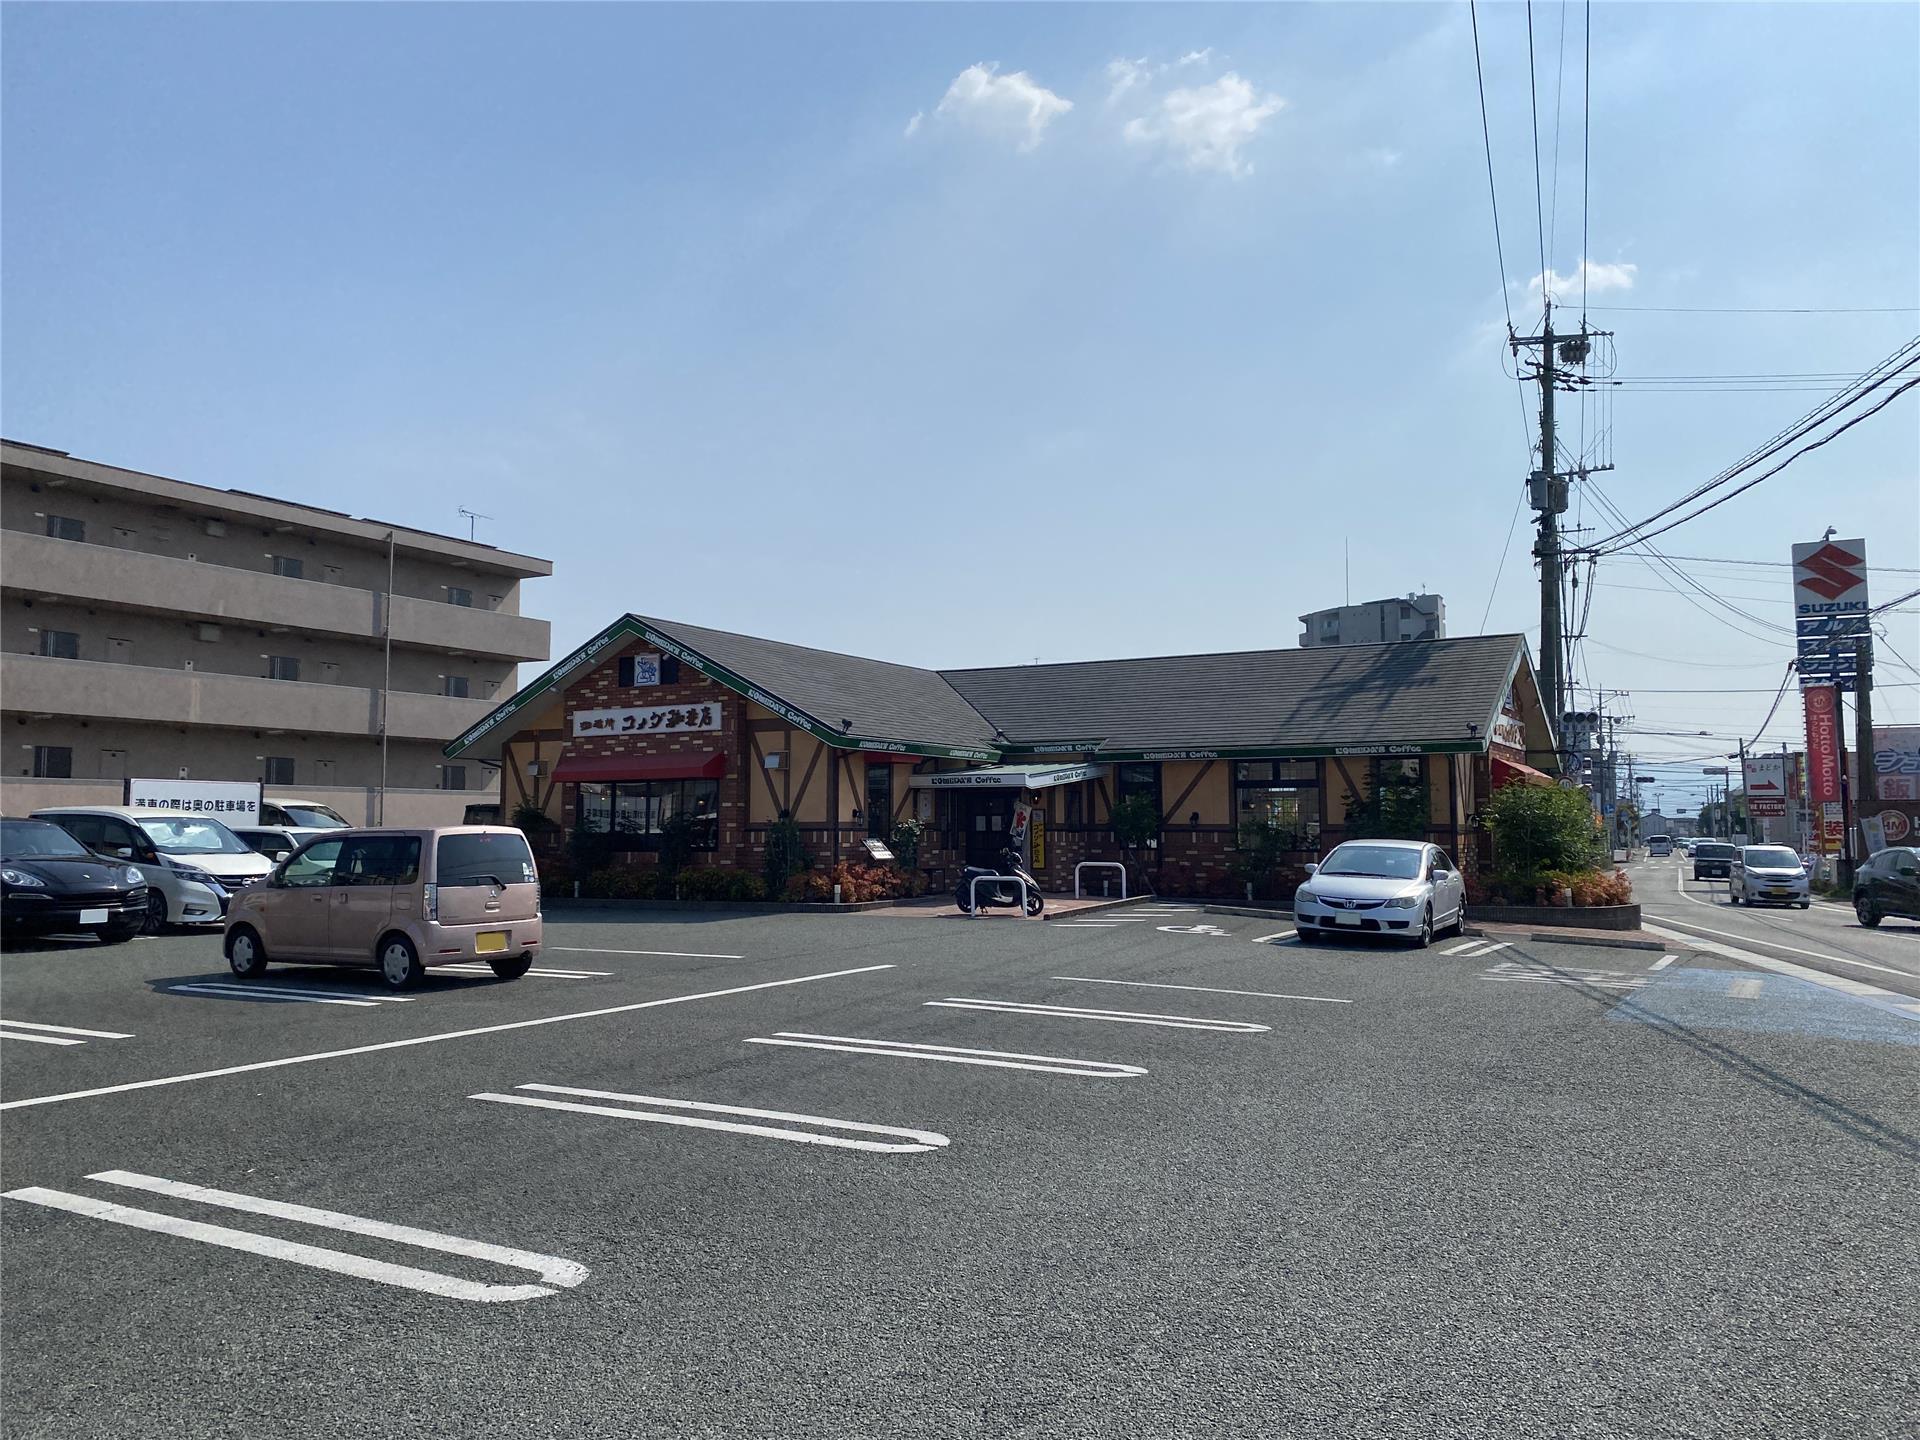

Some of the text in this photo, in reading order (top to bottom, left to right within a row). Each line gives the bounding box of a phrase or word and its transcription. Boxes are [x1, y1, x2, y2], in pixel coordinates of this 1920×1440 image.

[1798, 601, 1868, 614] SUZUKI
[587, 636, 609, 653] Coffee
[681, 651, 704, 669] Coffee
[495, 704, 516, 721] Coffee
[787, 711, 812, 730] Coffee
[888, 743, 906, 752] Coffee
[1388, 744, 1422, 753] Coffee
[973, 751, 988, 760] Coffee
[1189, 750, 1218, 758] Coffee
[1074, 768, 1088, 778] Coffee
[975, 776, 1001, 784] Coffee
[135, 798, 256, 812] 満車の際は奥の駐車場を
